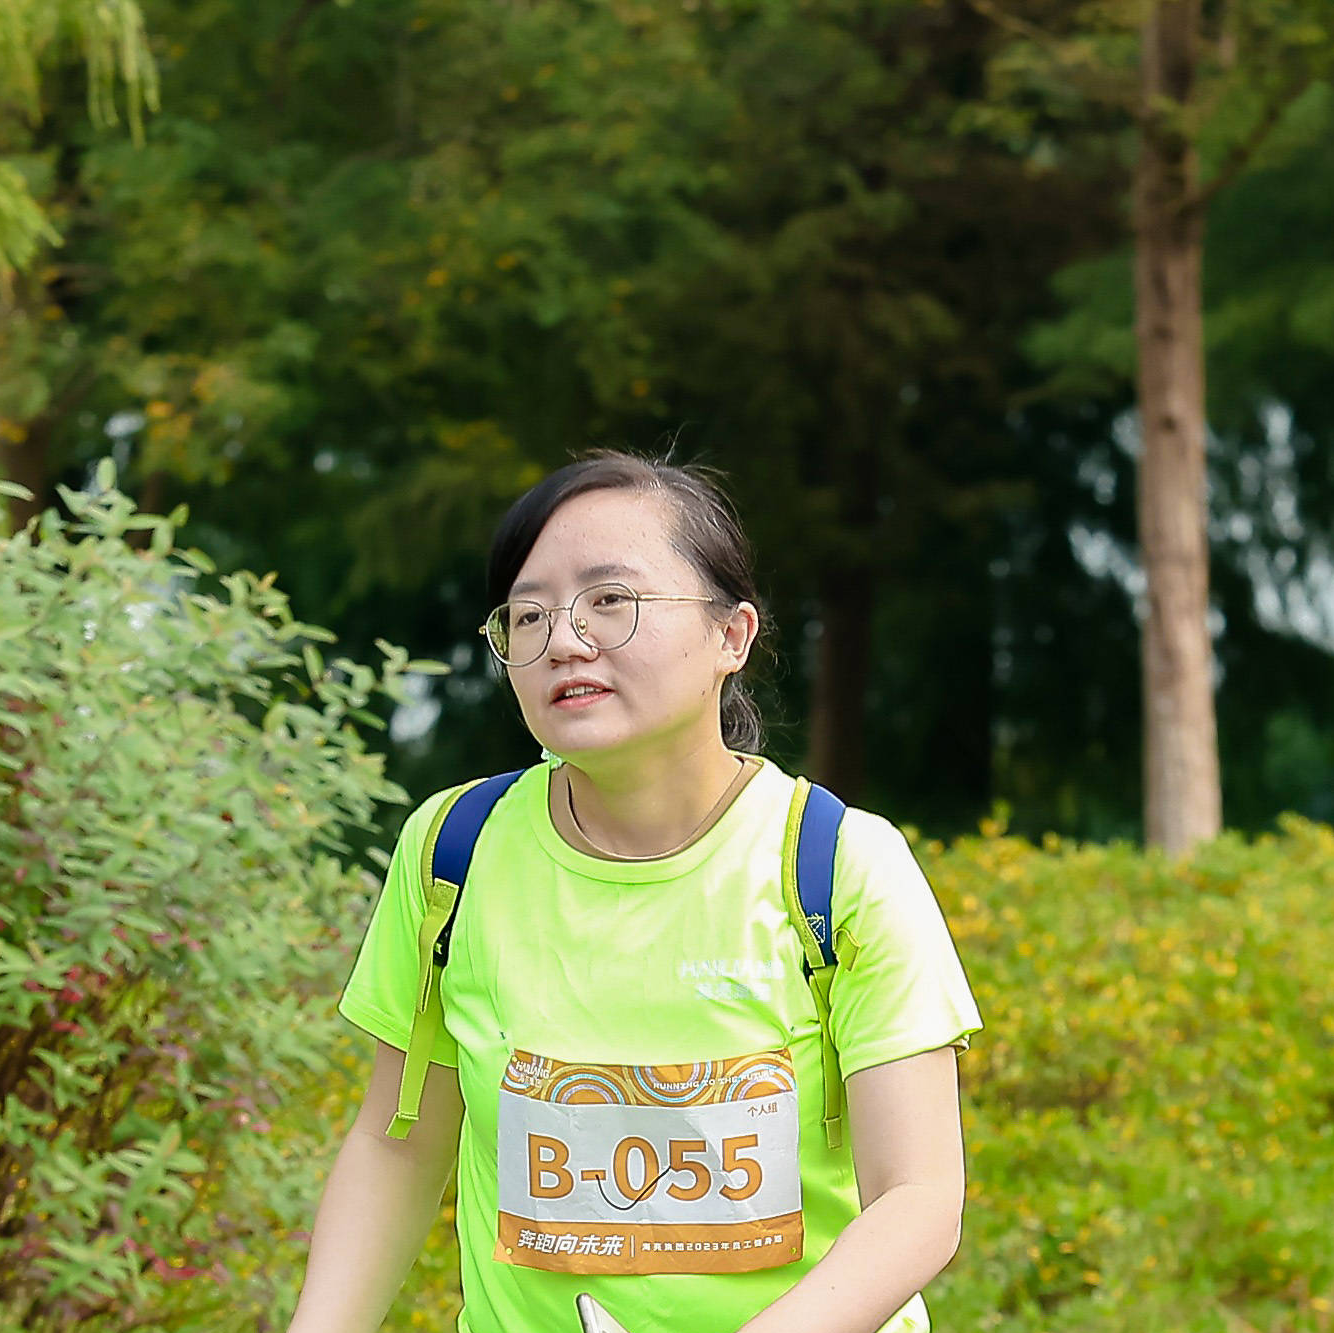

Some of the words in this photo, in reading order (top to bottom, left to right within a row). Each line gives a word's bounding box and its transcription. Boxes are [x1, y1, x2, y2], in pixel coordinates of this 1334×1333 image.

[748, 1102, 778, 1117] 个人组
[527, 1132, 763, 1202] B-055
[518, 1229, 624, 1256] 奔跑向未来
